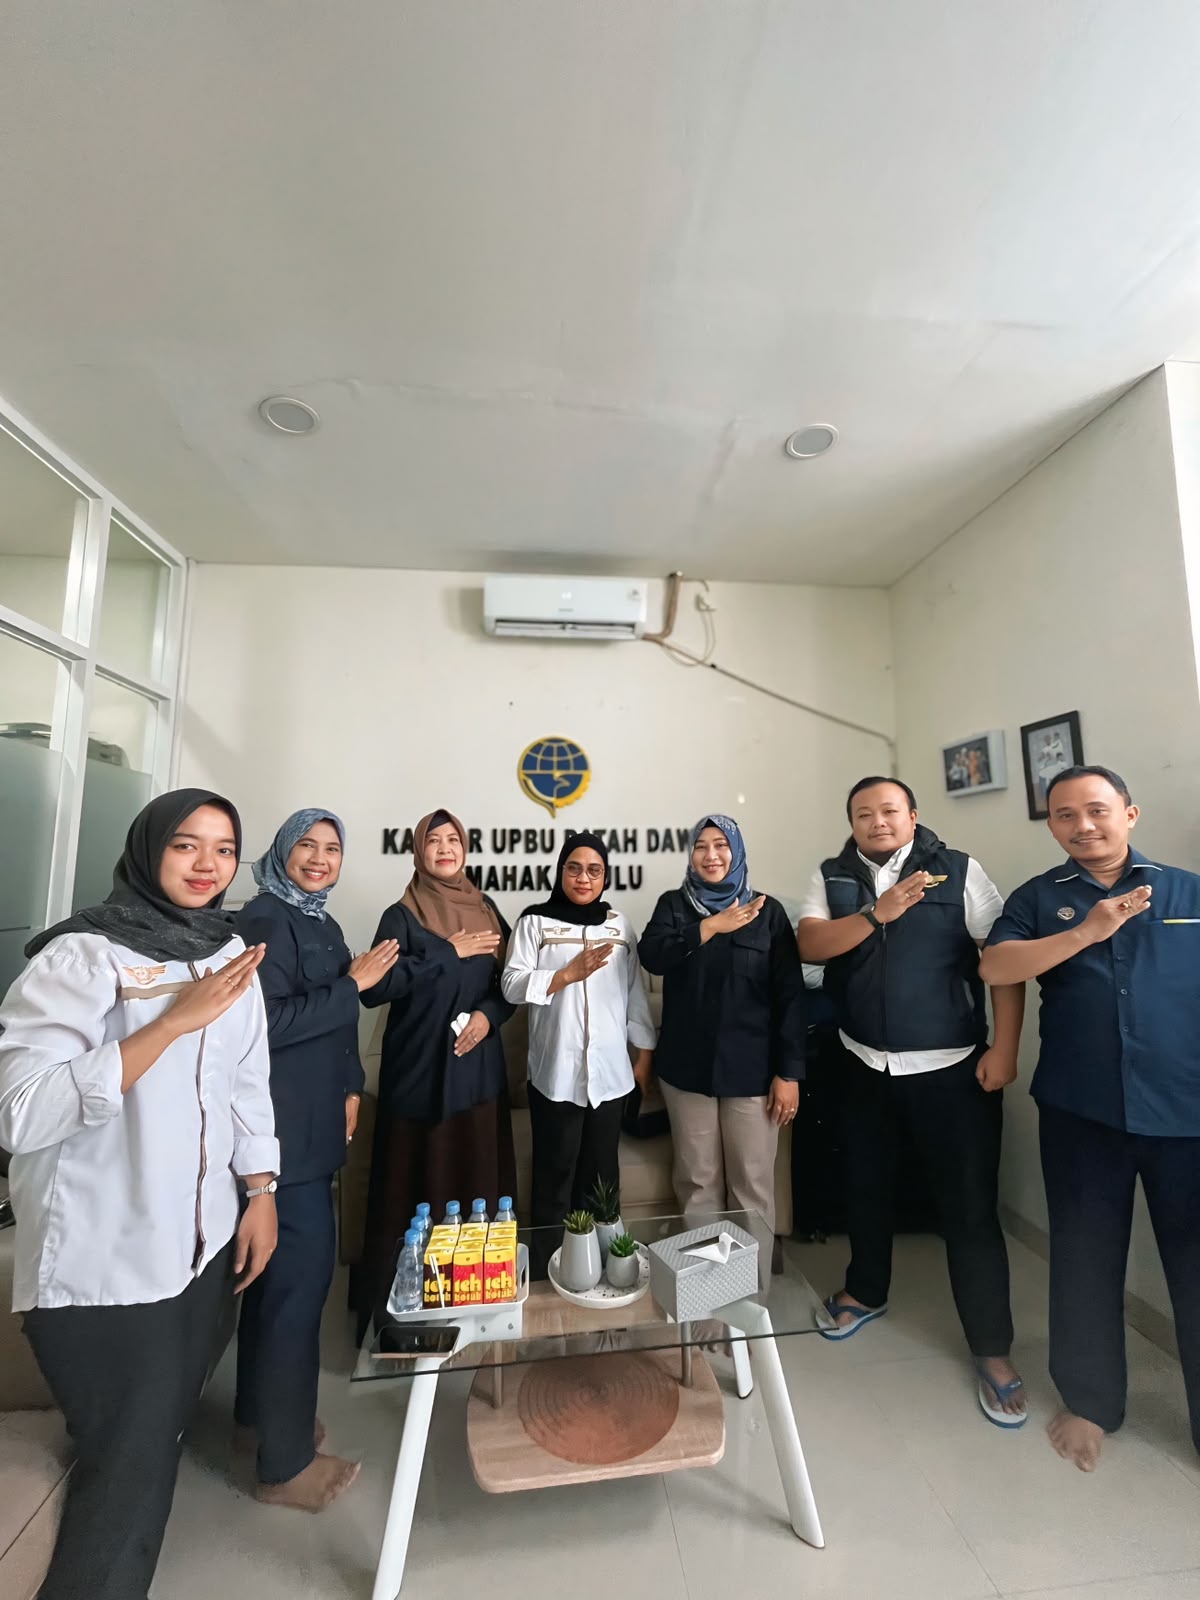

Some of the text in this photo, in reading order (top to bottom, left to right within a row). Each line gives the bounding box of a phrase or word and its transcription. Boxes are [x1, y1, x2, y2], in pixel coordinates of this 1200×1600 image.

[383, 828, 482, 854] KAR
[492, 828, 555, 854] UPBU
[465, 865, 553, 891] MAHAK
[424, 1273, 452, 1292] teh
[454, 1273, 481, 1292] teh
[485, 1271, 512, 1289] teh
